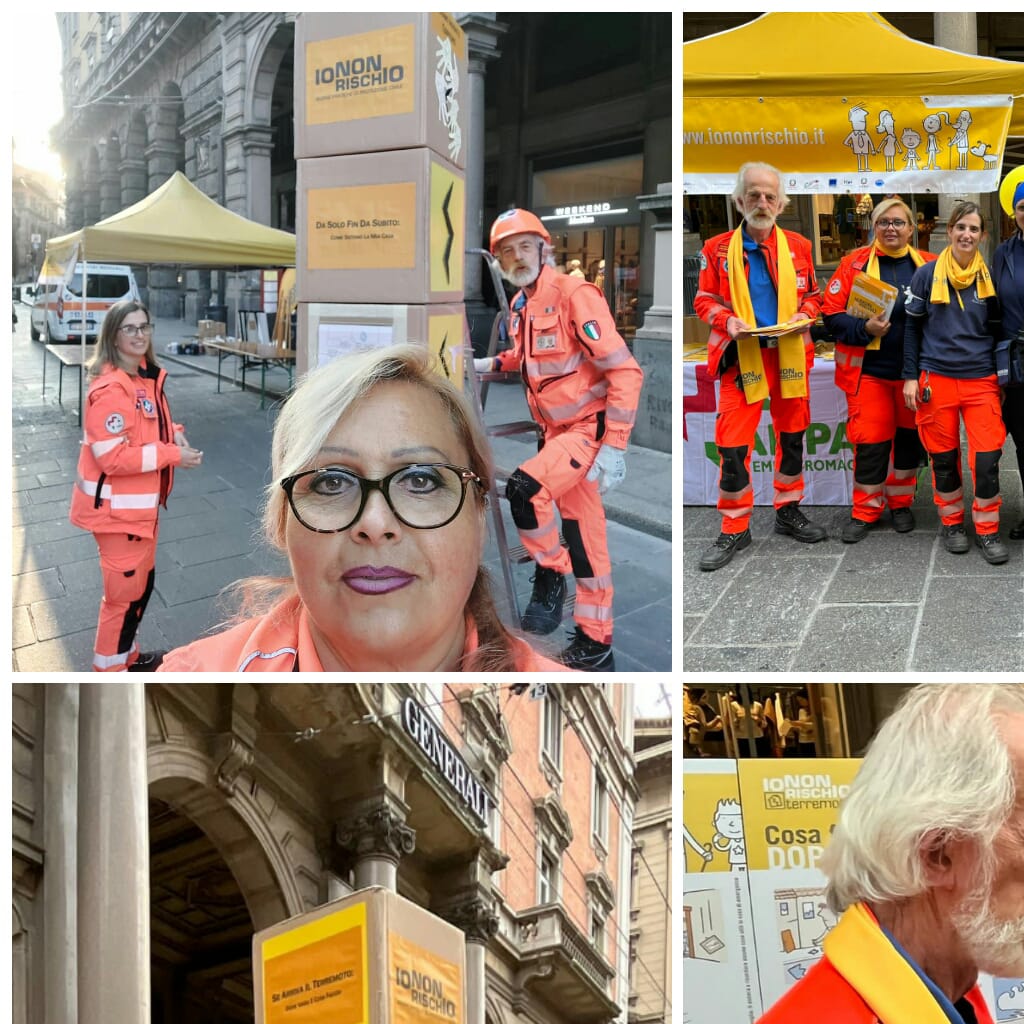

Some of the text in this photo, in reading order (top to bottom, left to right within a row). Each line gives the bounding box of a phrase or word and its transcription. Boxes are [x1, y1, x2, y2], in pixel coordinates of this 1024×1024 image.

[335, 65, 404, 91] RISCHIO
[683, 127, 826, 145] ww.iononrischio.it
[405, 697, 489, 823] GENERALI
[786, 799, 841, 809] terremo
[765, 825, 821, 845] Cosa
[767, 846, 825, 869] DOP
[411, 988, 457, 1018] RISCHIO
